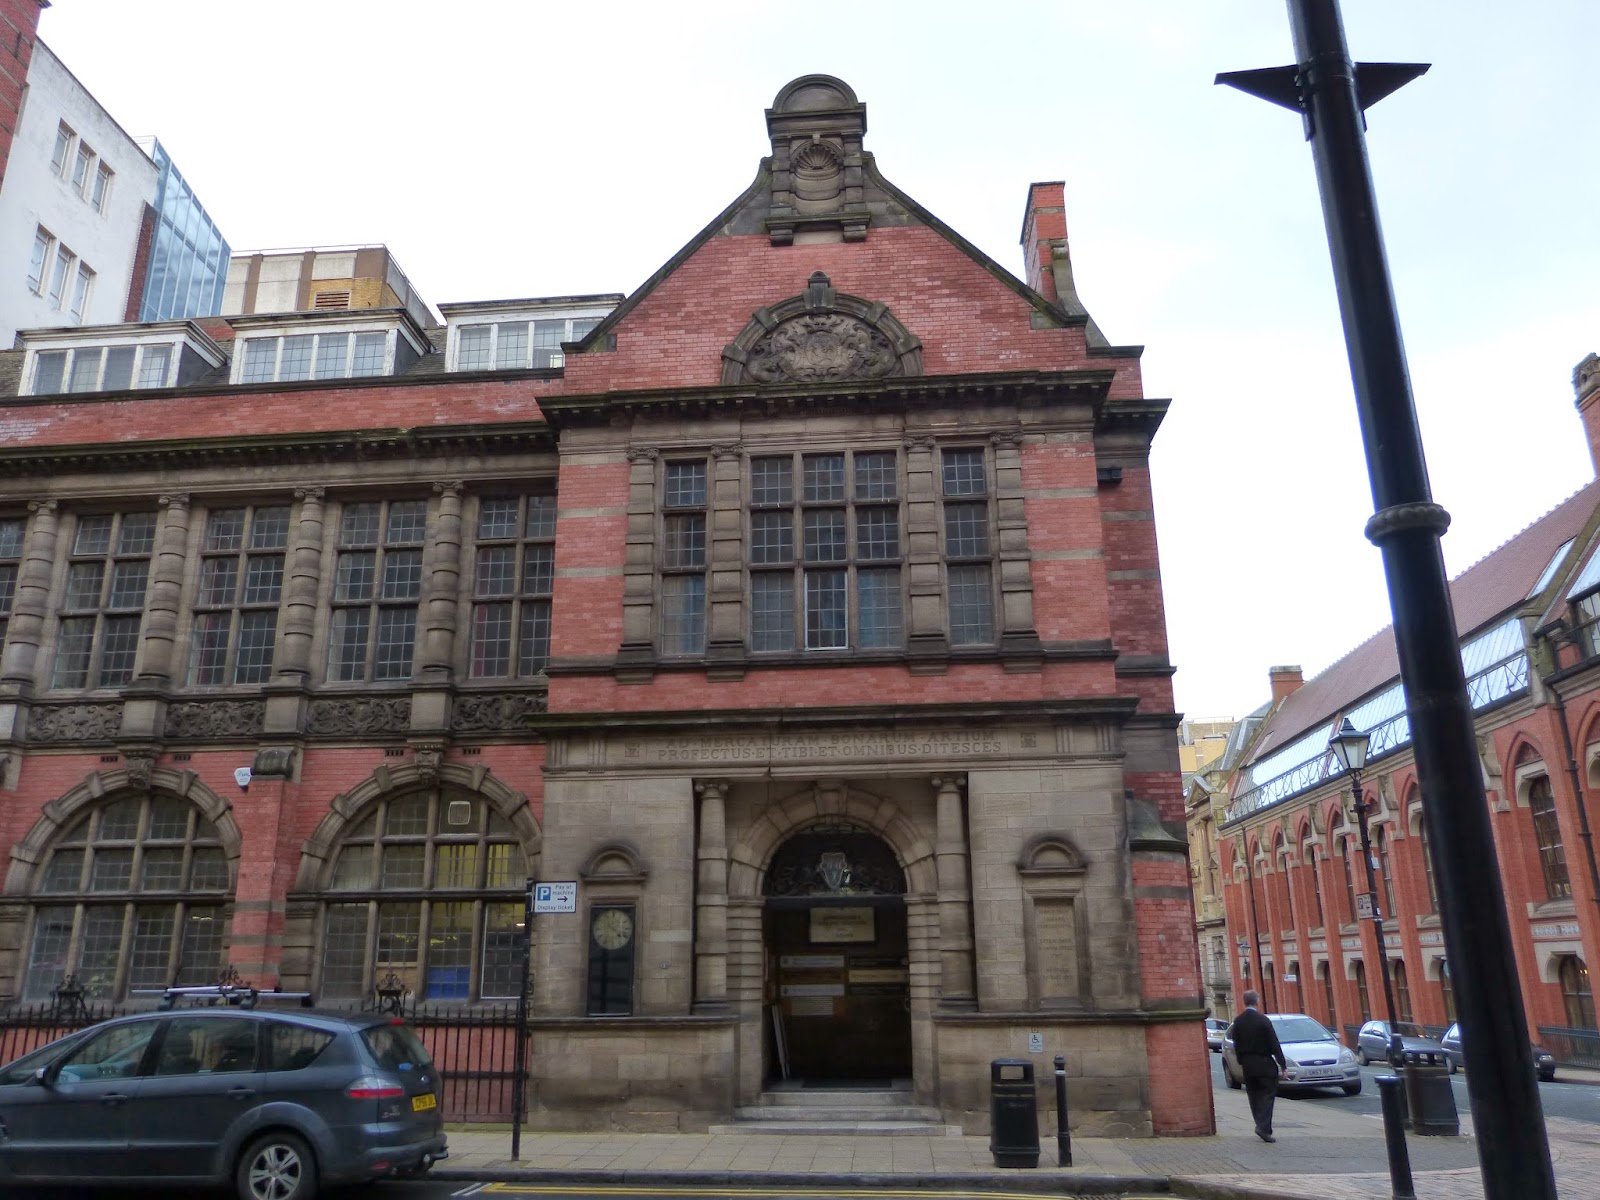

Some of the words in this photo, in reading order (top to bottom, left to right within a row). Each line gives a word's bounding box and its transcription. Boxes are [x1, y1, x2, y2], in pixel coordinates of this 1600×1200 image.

[700, 735, 819, 748] MERCATURAM
[831, 733, 915, 745] BONARUM
[928, 730, 994, 742] ARTIUM
[658, 749, 750, 760] PROFECTUS
[843, 743, 918, 756] OMNIBUS
[922, 741, 1002, 754] DITESCES
[540, 887, 550, 900] P
